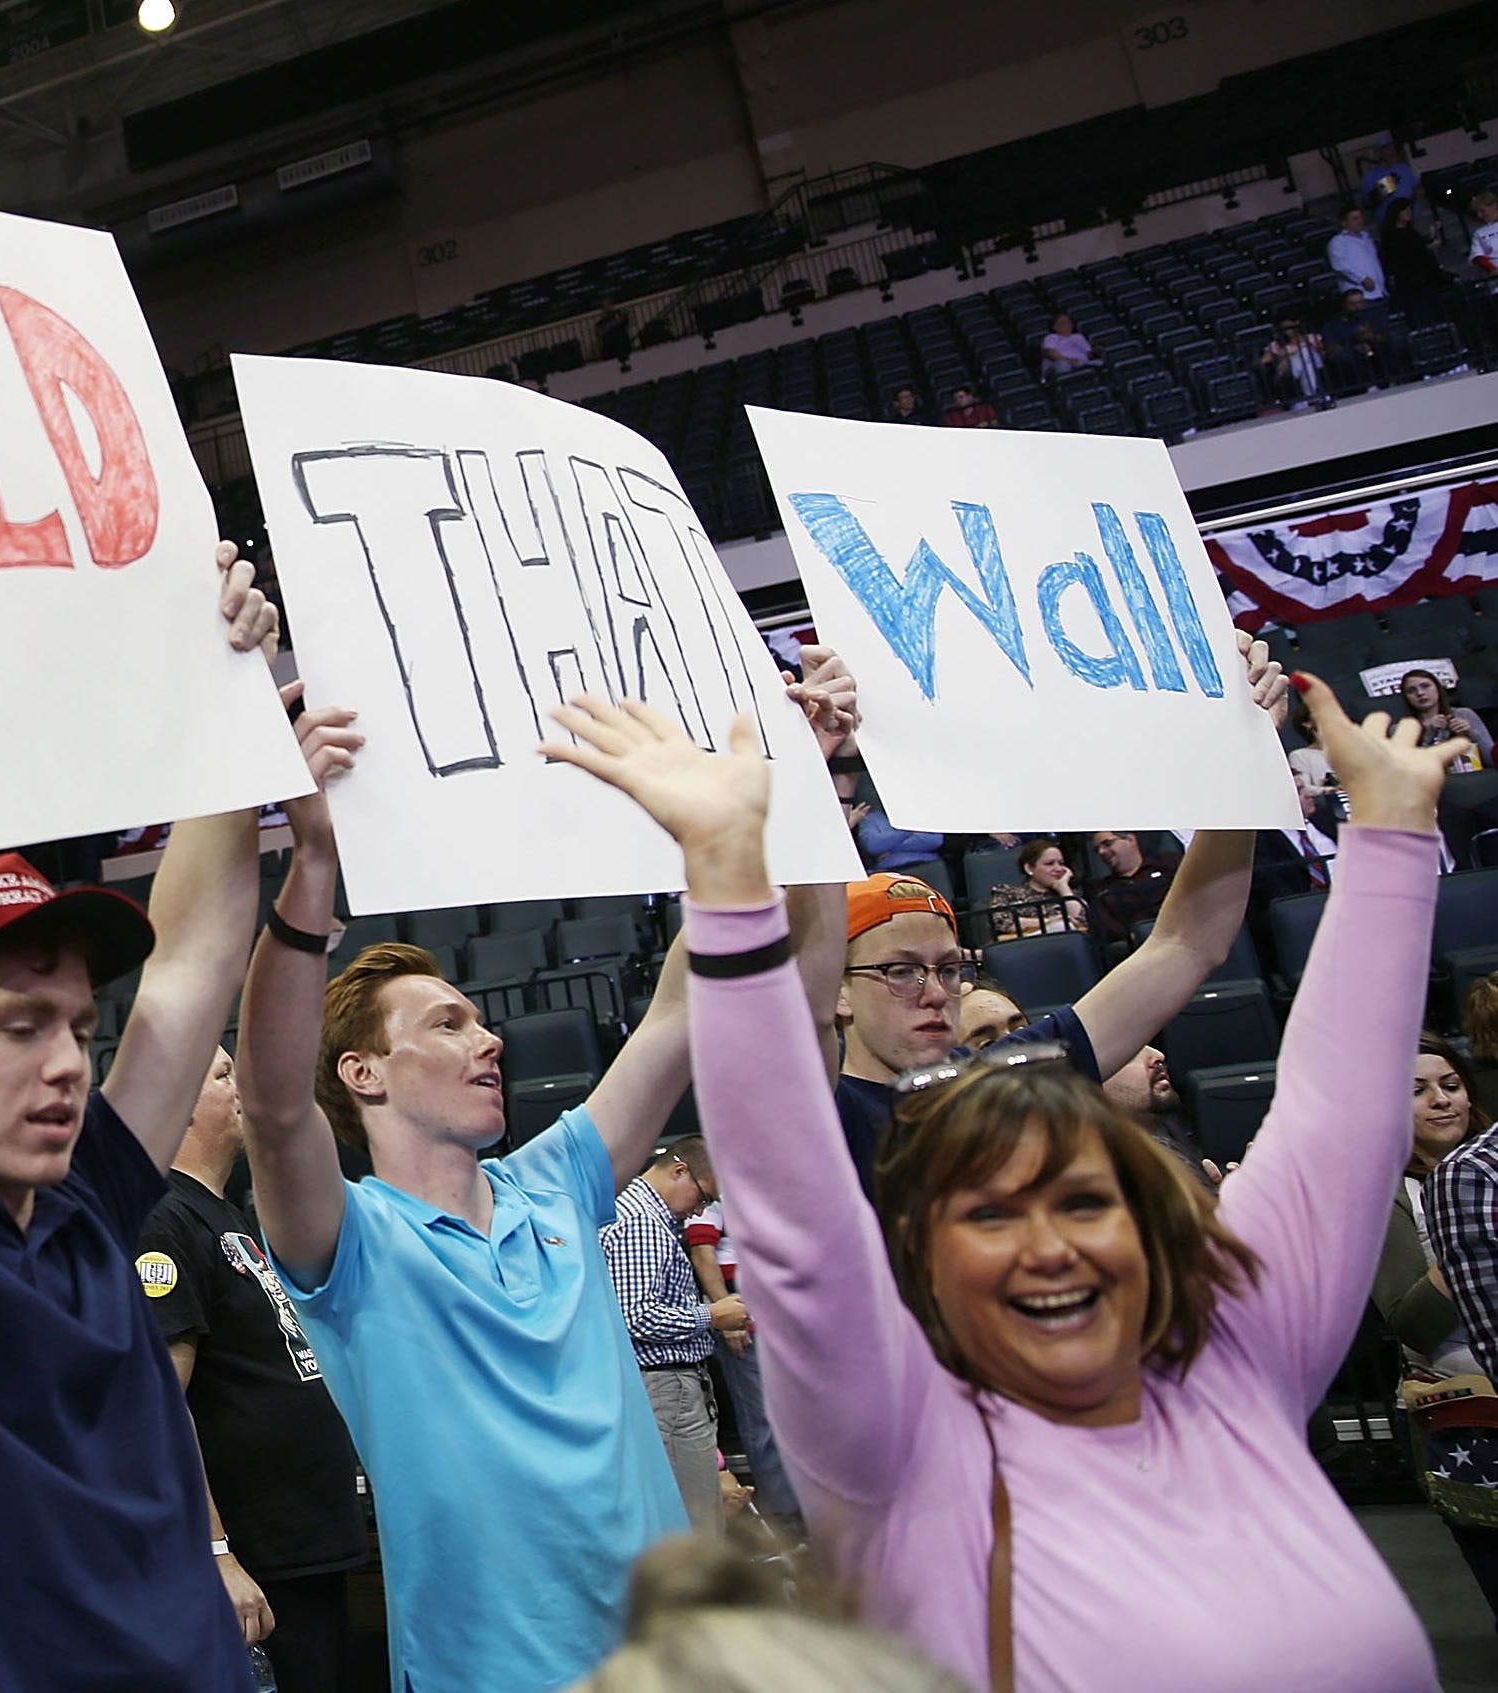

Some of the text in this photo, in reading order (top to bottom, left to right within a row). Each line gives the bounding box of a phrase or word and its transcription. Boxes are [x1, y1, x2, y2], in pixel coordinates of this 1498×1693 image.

[1134, 15, 1189, 49] 303
[418, 239, 458, 267] 302
[292, 441, 775, 777] THAT
[790, 493, 1225, 704] Wall
